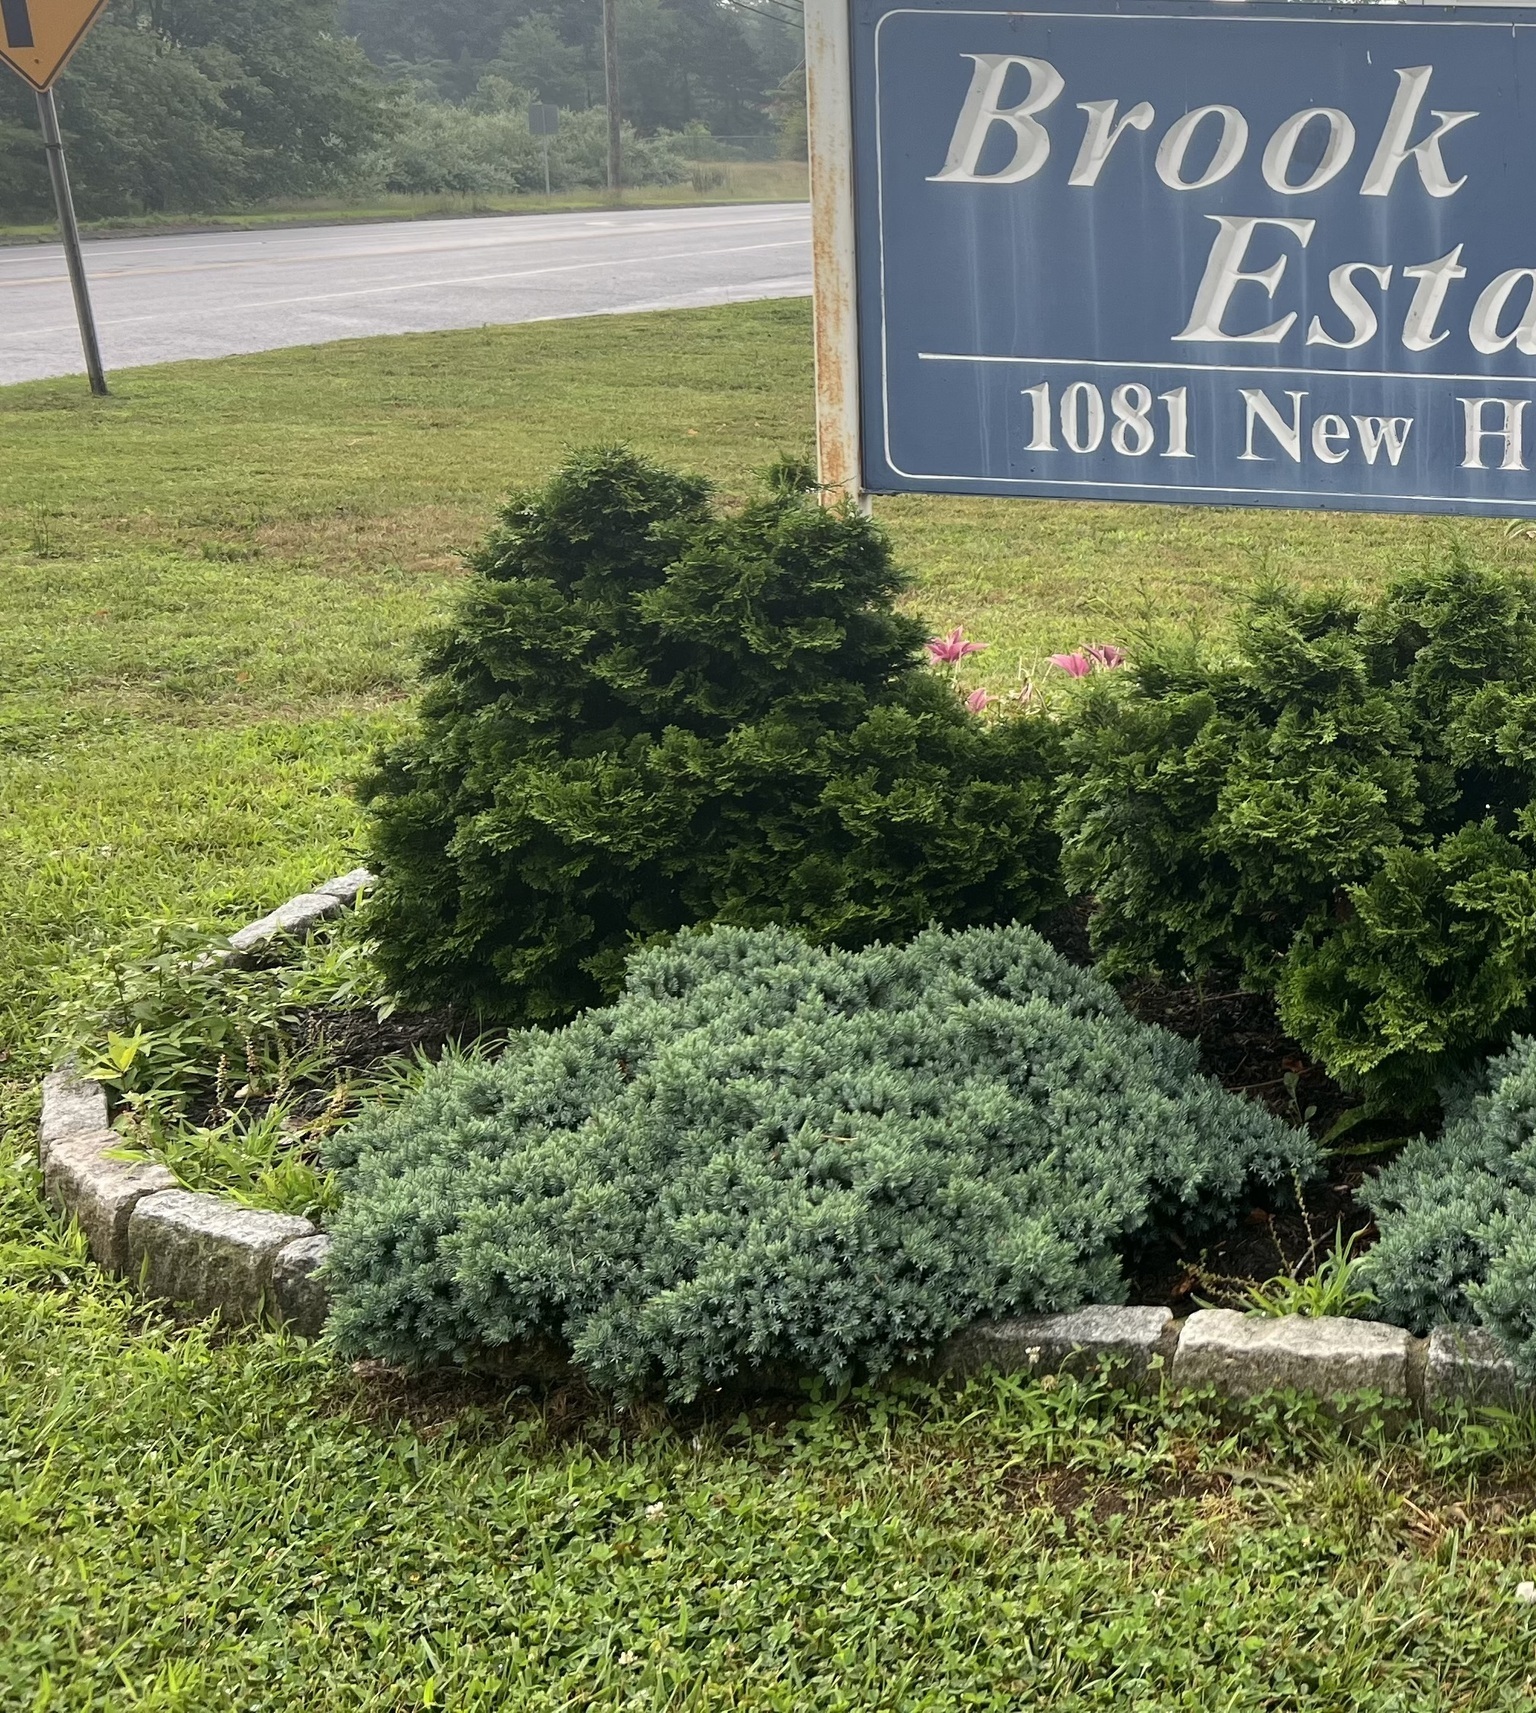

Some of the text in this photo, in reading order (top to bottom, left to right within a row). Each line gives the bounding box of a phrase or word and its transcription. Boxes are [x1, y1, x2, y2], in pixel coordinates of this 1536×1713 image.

[925, 53, 1480, 198] Brook
[1020, 380, 1196, 459] 1081
[1236, 388, 1414, 467] New
